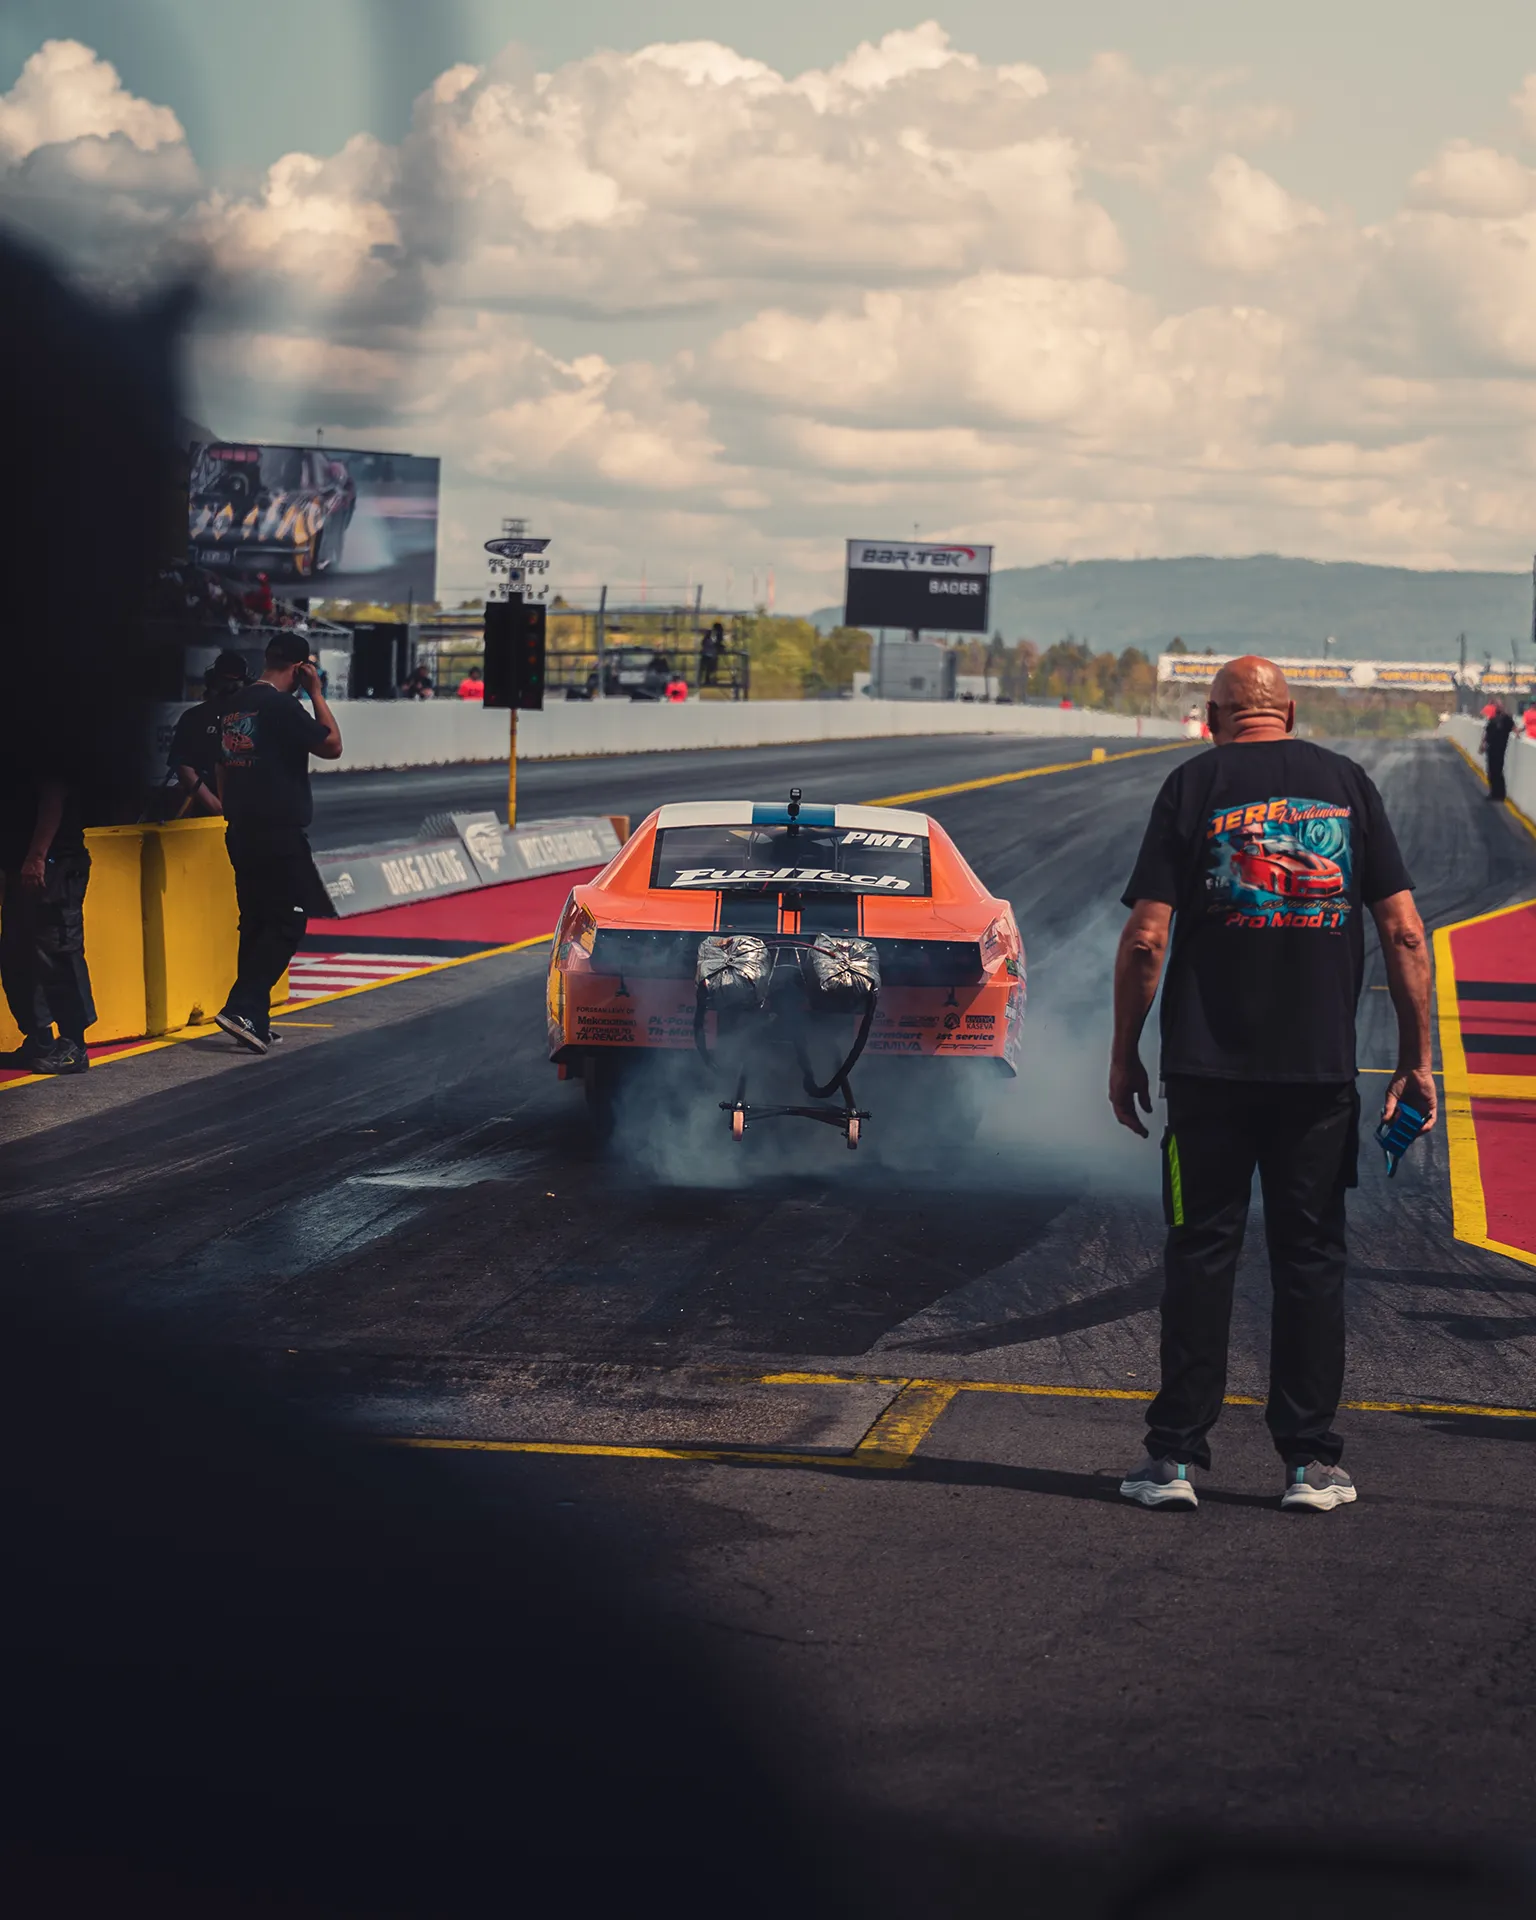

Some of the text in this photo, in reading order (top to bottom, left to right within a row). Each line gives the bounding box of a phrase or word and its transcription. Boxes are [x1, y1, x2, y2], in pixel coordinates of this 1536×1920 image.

[498, 584, 531, 592] STAGED
[929, 580, 980, 595] BADER
[1207, 799, 1288, 838] JERE
[841, 831, 915, 849] PM1
[670, 867, 911, 890] FuelTech
[1225, 912, 1267, 928] Pro
[1271, 911, 1324, 928] Mod
[956, 1033, 995, 1041] service
